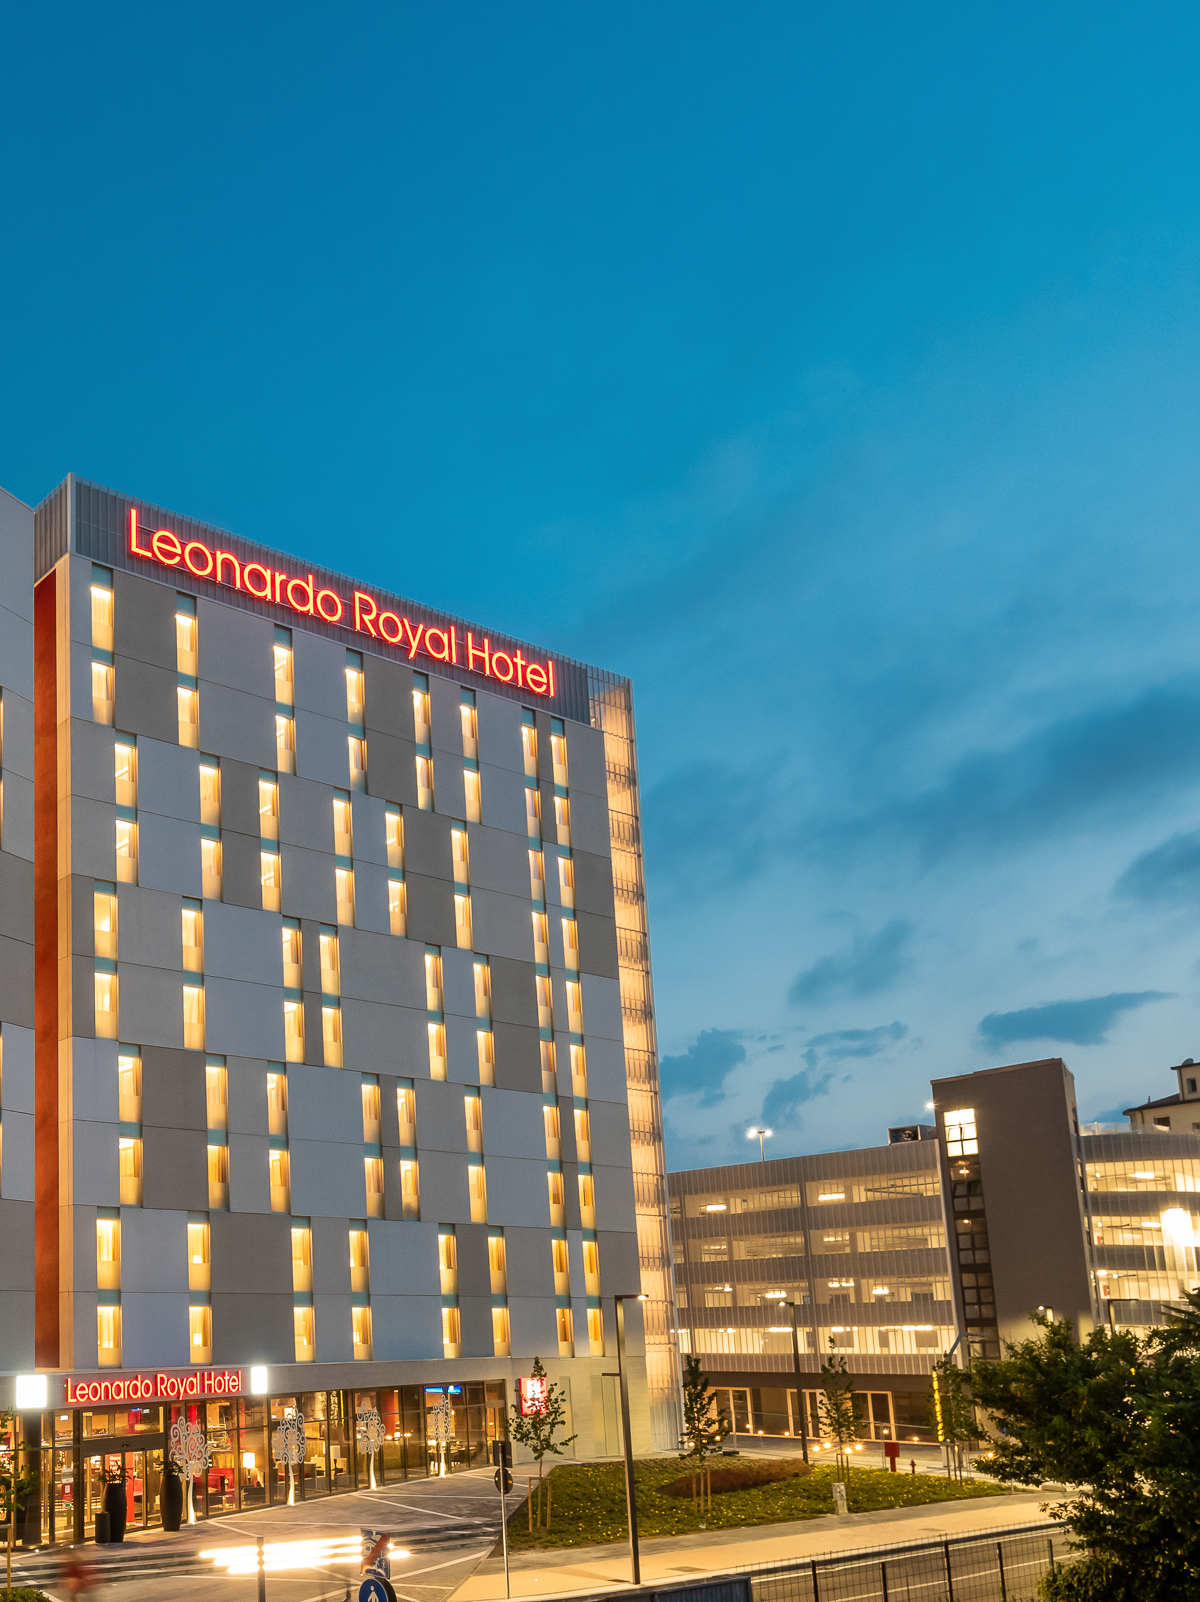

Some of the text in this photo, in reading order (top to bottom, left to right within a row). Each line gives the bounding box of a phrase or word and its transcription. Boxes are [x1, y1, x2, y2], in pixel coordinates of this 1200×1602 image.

[129, 508, 555, 697] Leonardo Royal Hotel
[67, 1370, 242, 1403] Leonardo Royal Hotel
